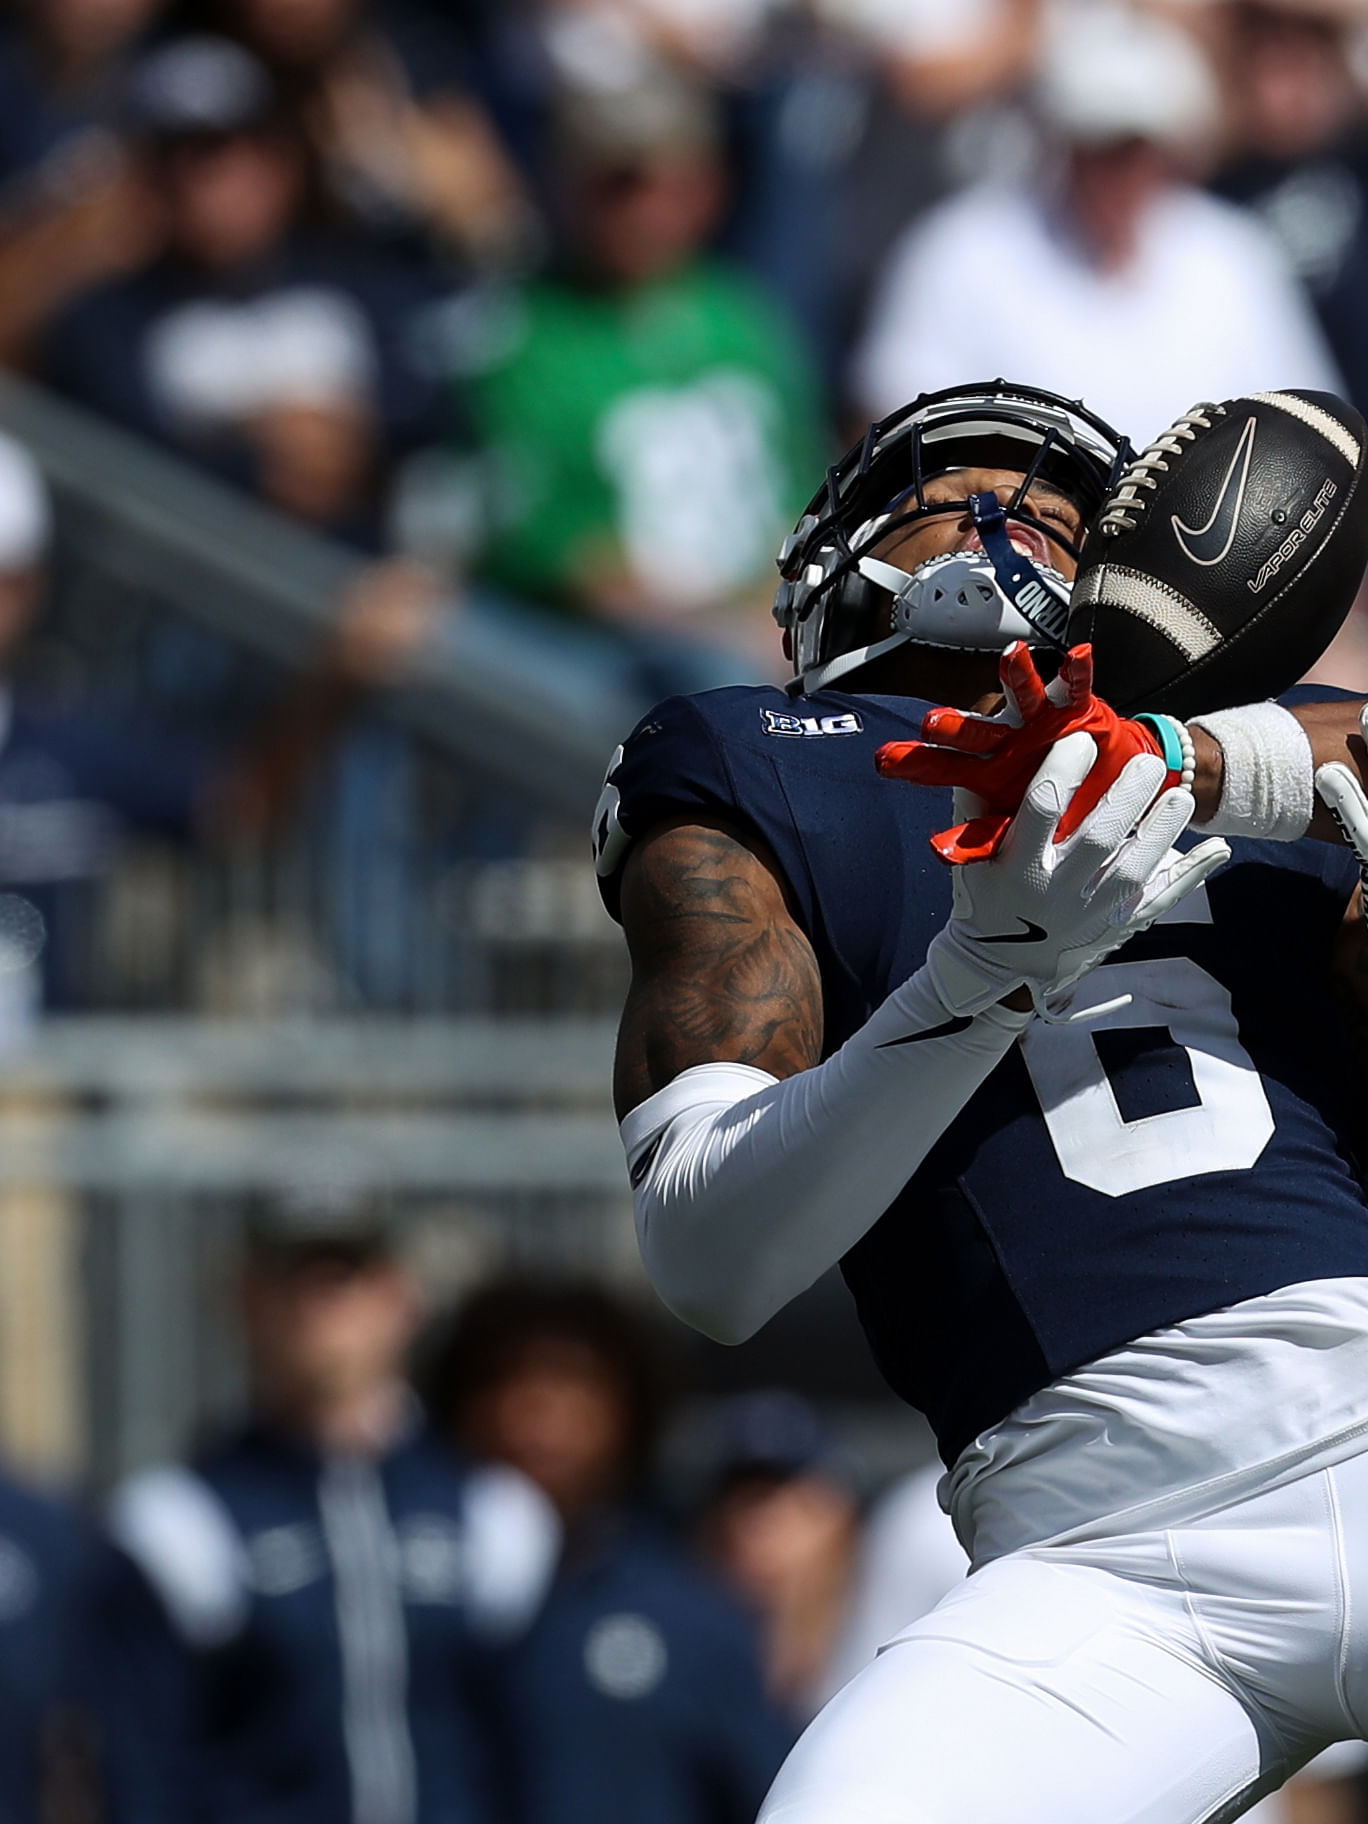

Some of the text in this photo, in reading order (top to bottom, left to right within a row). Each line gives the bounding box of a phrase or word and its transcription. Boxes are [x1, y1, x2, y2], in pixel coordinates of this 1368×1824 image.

[1246, 478, 1338, 594] VAPOR ELITE
[1016, 848, 1277, 1198] 6
